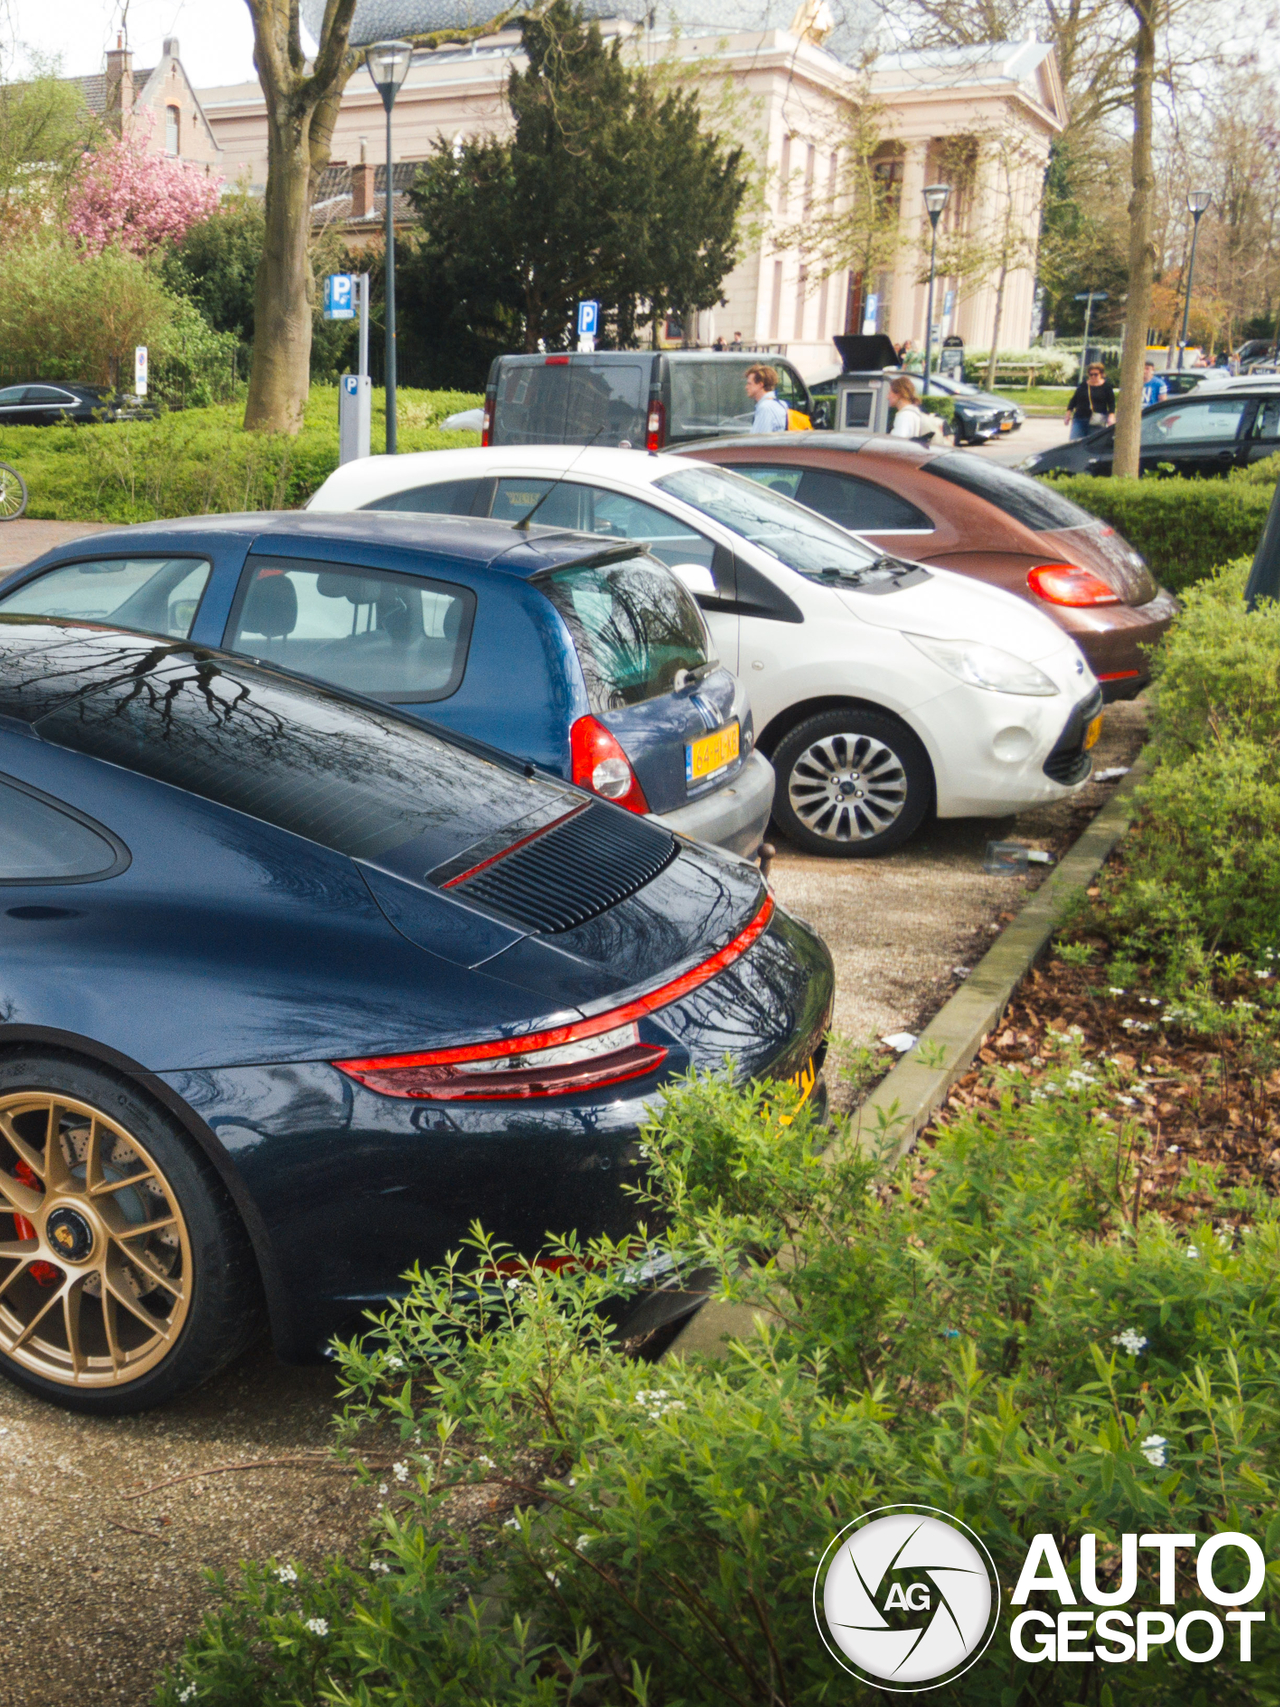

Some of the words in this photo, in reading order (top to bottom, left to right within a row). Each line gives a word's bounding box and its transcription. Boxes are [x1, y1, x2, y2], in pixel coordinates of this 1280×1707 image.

[333, 276, 351, 302] P
[582, 306, 594, 331] P
[347, 378, 358, 392] P
